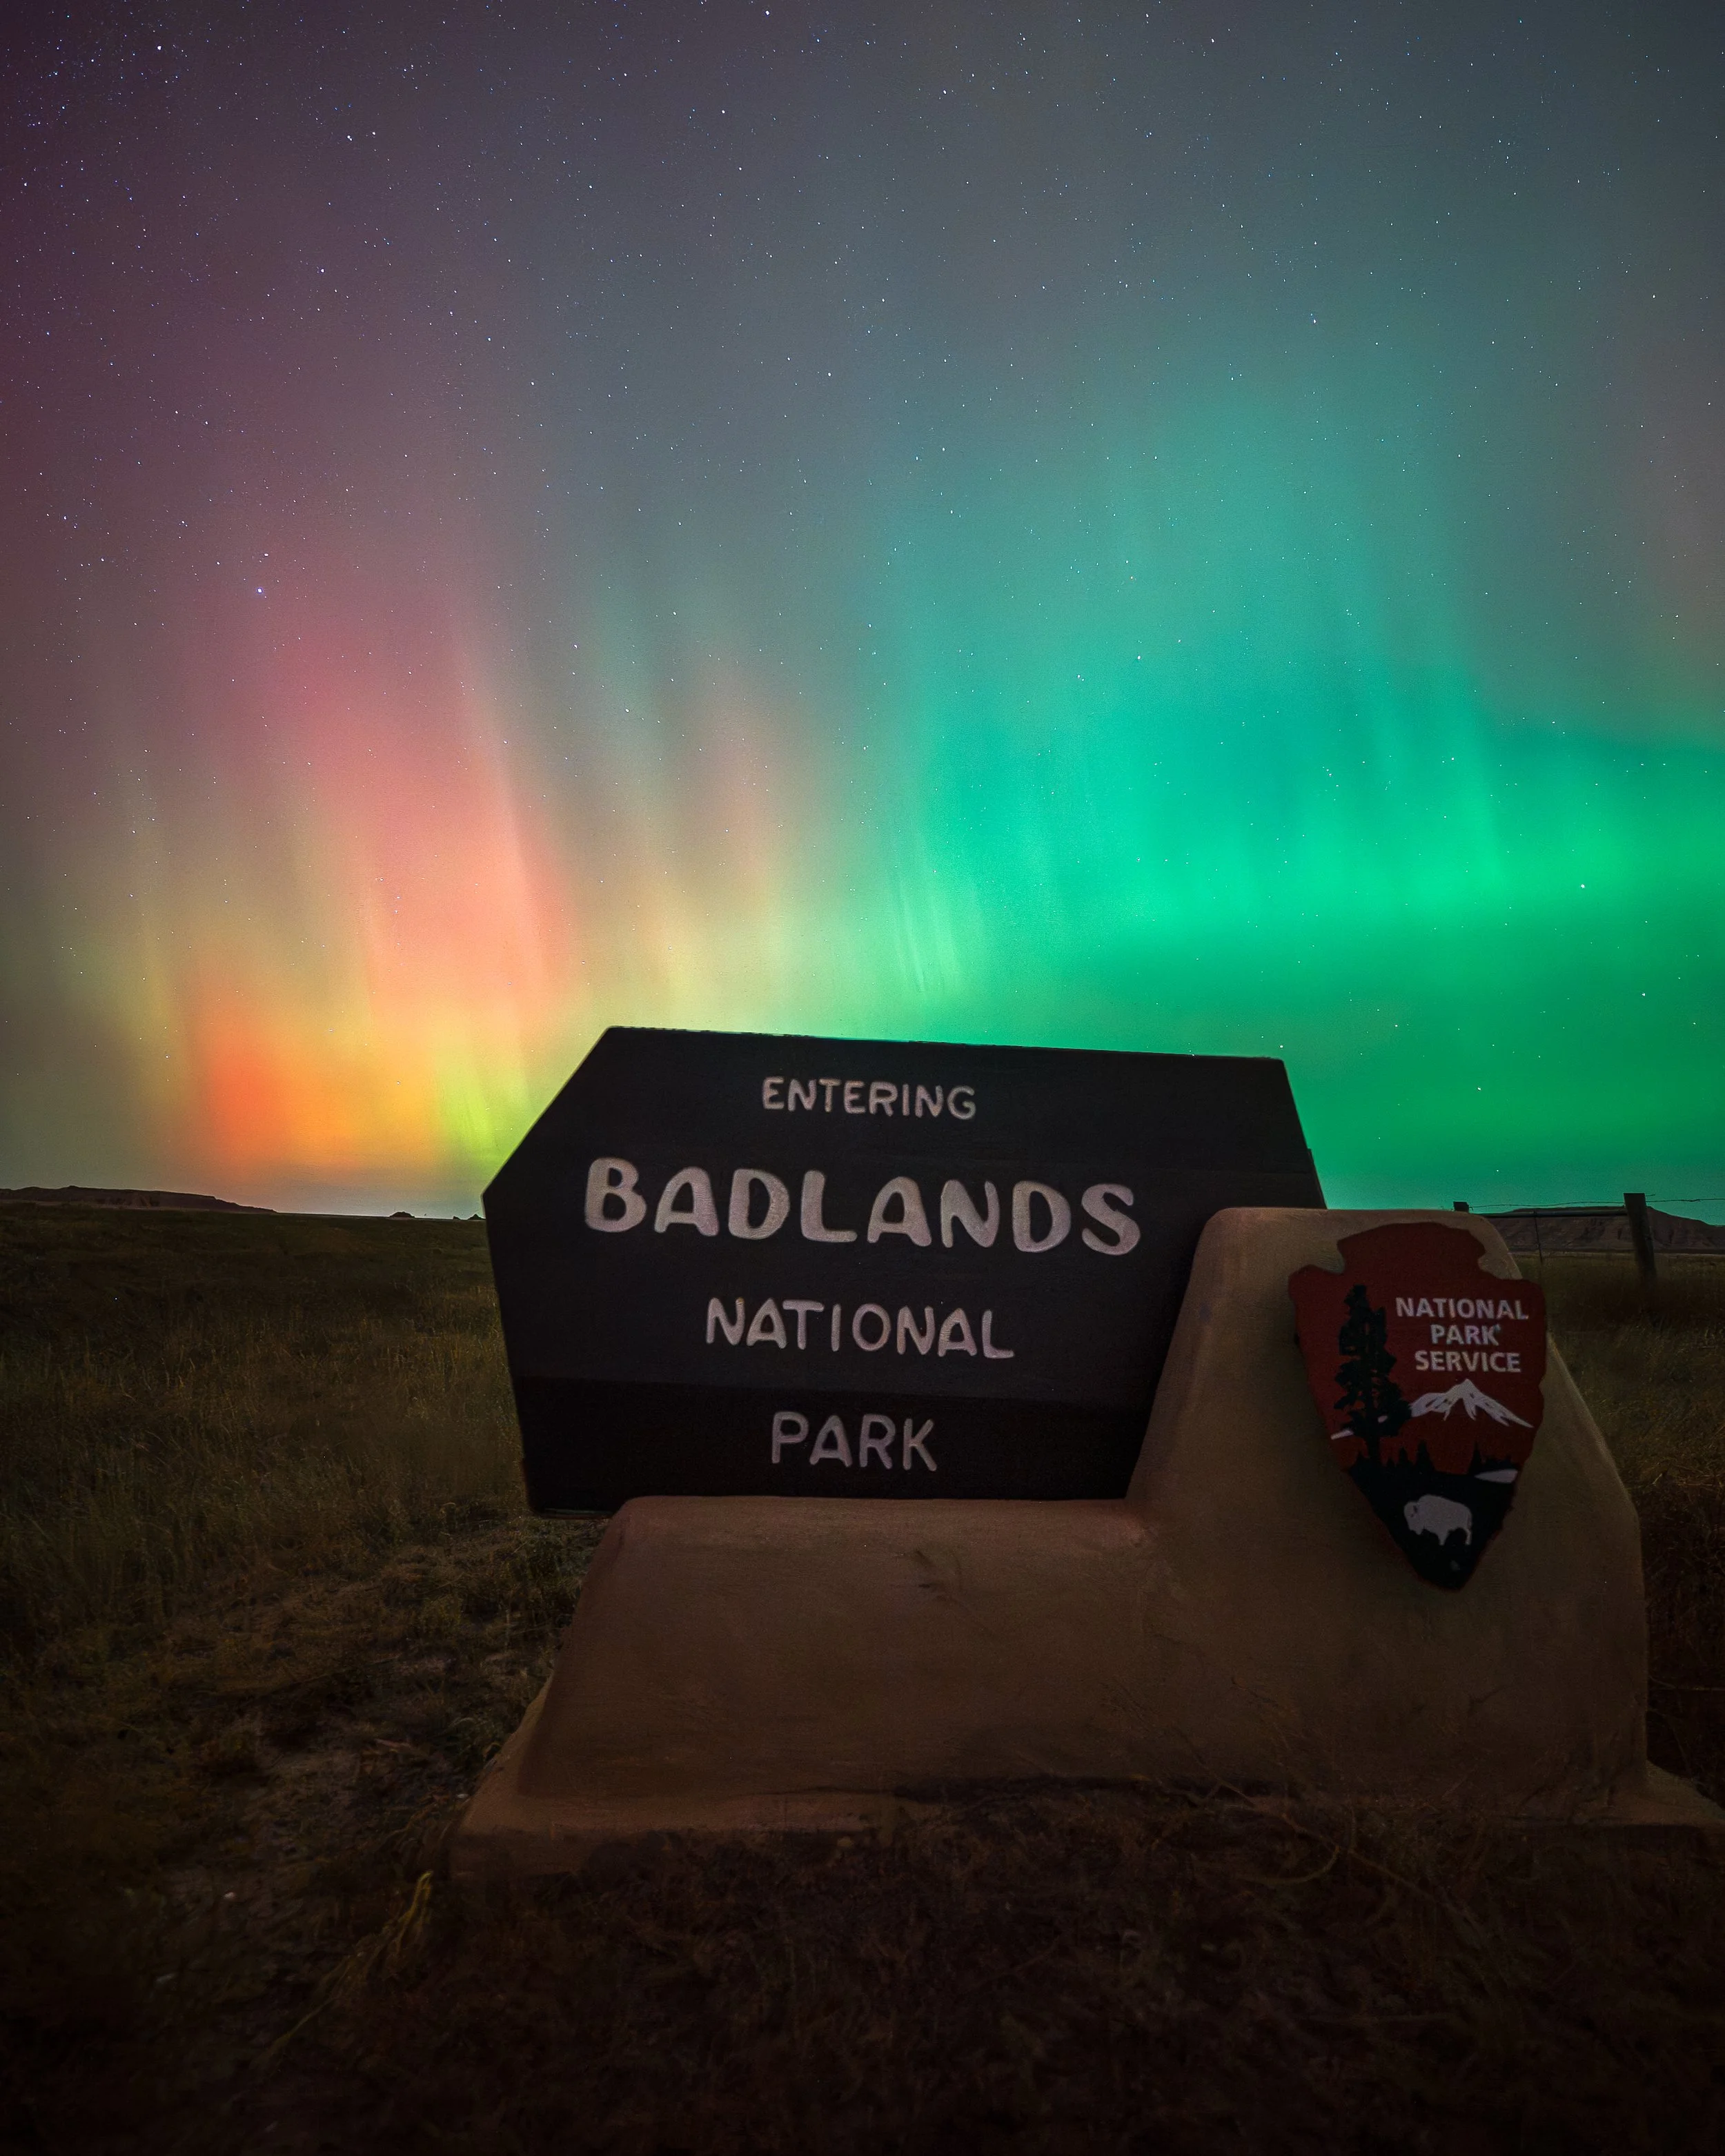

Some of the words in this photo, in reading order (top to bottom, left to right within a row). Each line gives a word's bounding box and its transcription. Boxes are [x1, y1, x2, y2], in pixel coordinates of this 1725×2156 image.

[762, 1076, 976, 1120] ENTERING
[584, 1157, 1141, 1256] BADLANDS
[705, 1296, 1015, 1359] NATIONAL
[1394, 1296, 1530, 1321] NATIONAL
[1429, 1323, 1500, 1347] PARK
[1414, 1349, 1521, 1373] SERVICE
[771, 1411, 938, 1472] PARK
